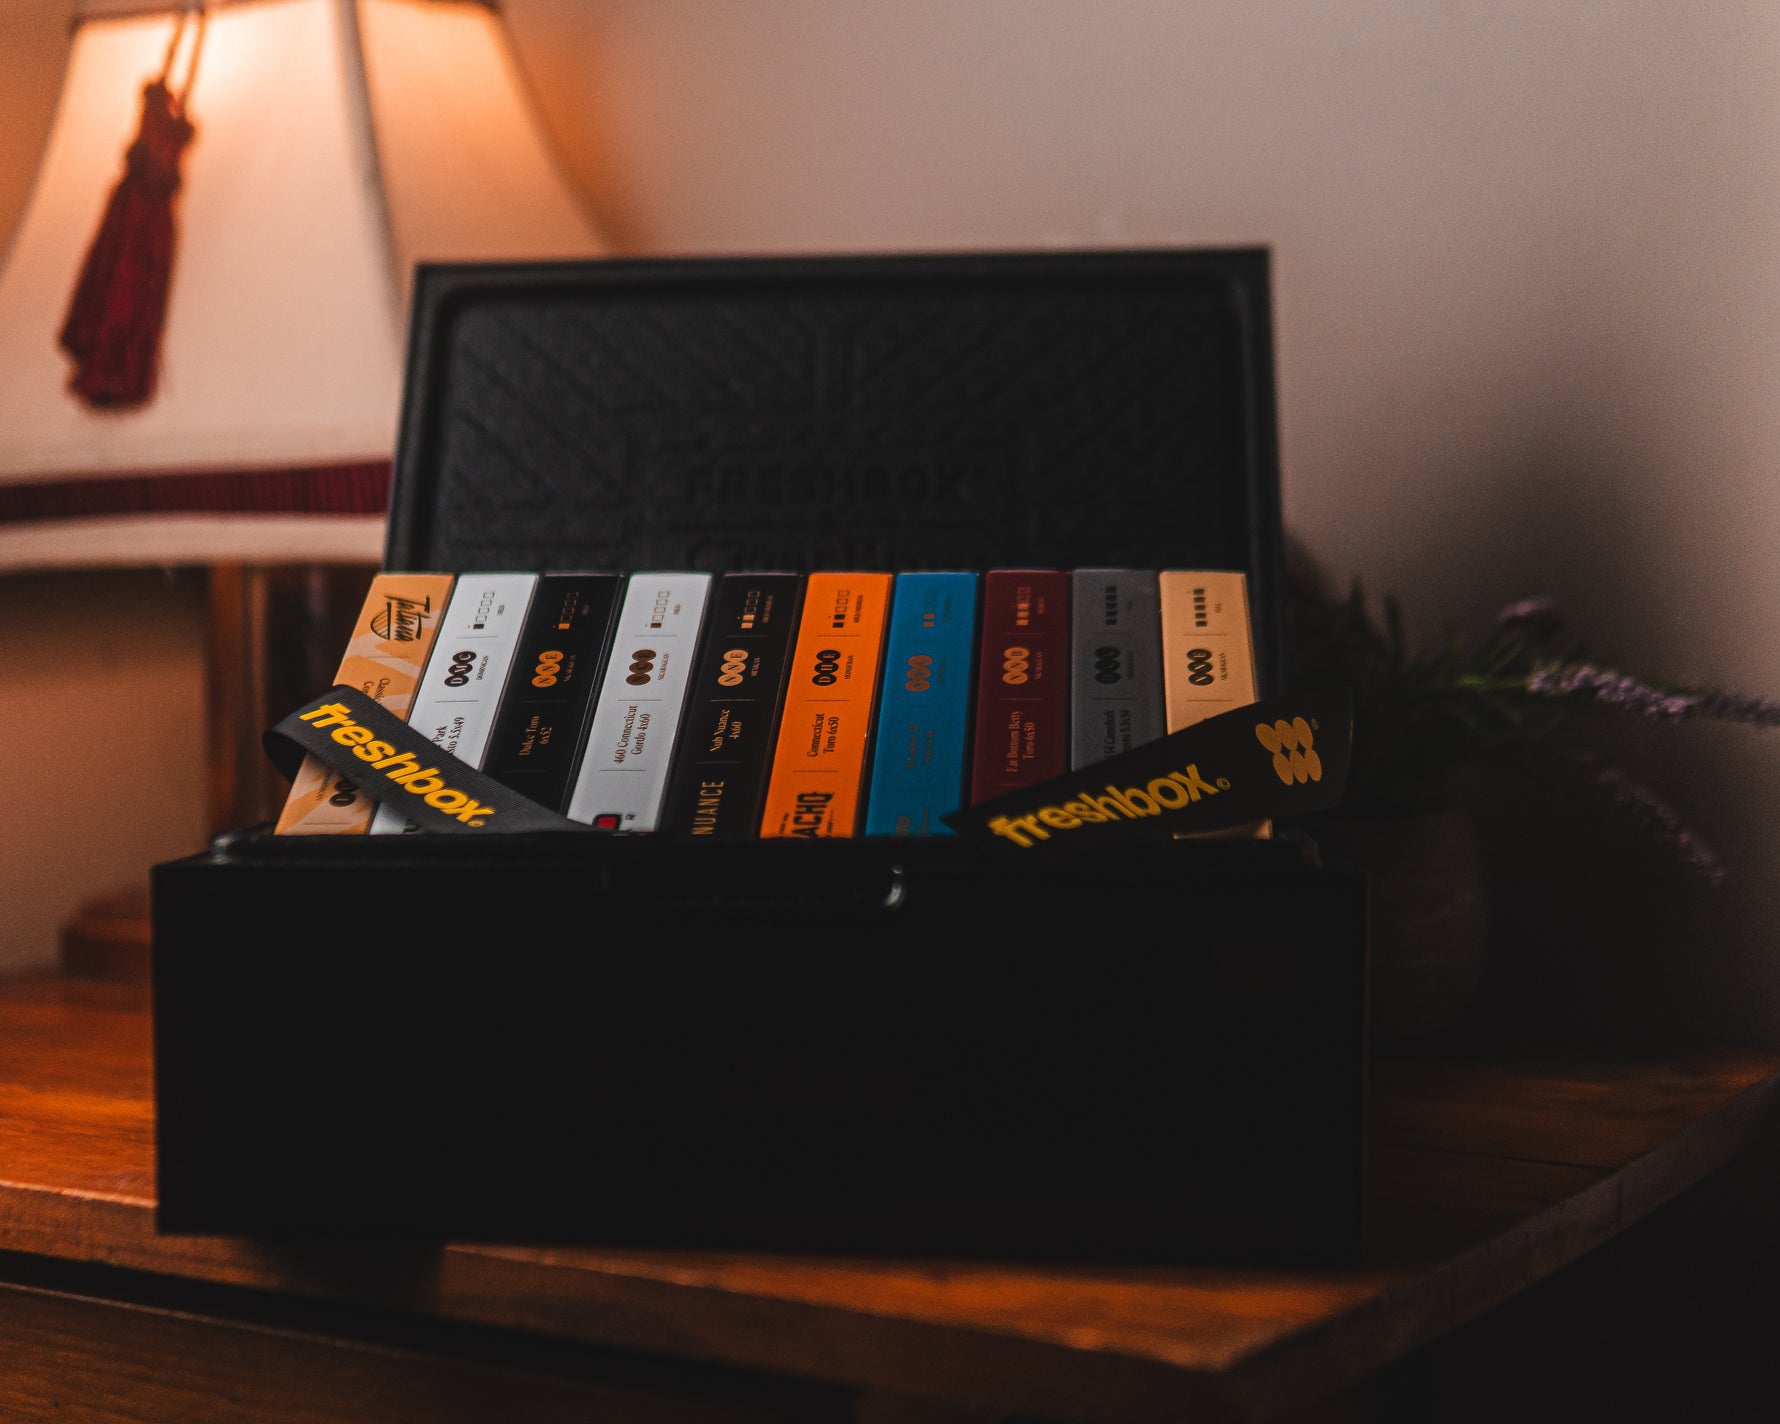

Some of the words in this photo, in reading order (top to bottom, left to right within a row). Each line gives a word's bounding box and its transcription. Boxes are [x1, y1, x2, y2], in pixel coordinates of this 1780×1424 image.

[525, 715, 540, 732] Toro
[617, 705, 638, 748] Connecticut
[637, 713, 651, 732] 4x60
[714, 709, 730, 736] Nuance
[729, 721, 743, 740] 4x60
[827, 716, 840, 736] 6x50
[1008, 711, 1023, 730] Betty
[539, 727, 552, 745] 6x52
[806, 713, 825, 758] Connecticut
[1024, 721, 1035, 741] 6x50
[519, 732, 536, 756] Dulce
[631, 731, 646, 755] Gordo
[823, 735, 836, 755] Toro
[1007, 731, 1020, 759] Bottom
[1023, 740, 1035, 760] Toro
[299, 703, 496, 823] freshbox
[614, 749, 626, 764] 460
[691, 780, 724, 835] NUANCE
[988, 763, 1220, 848] freshbox
